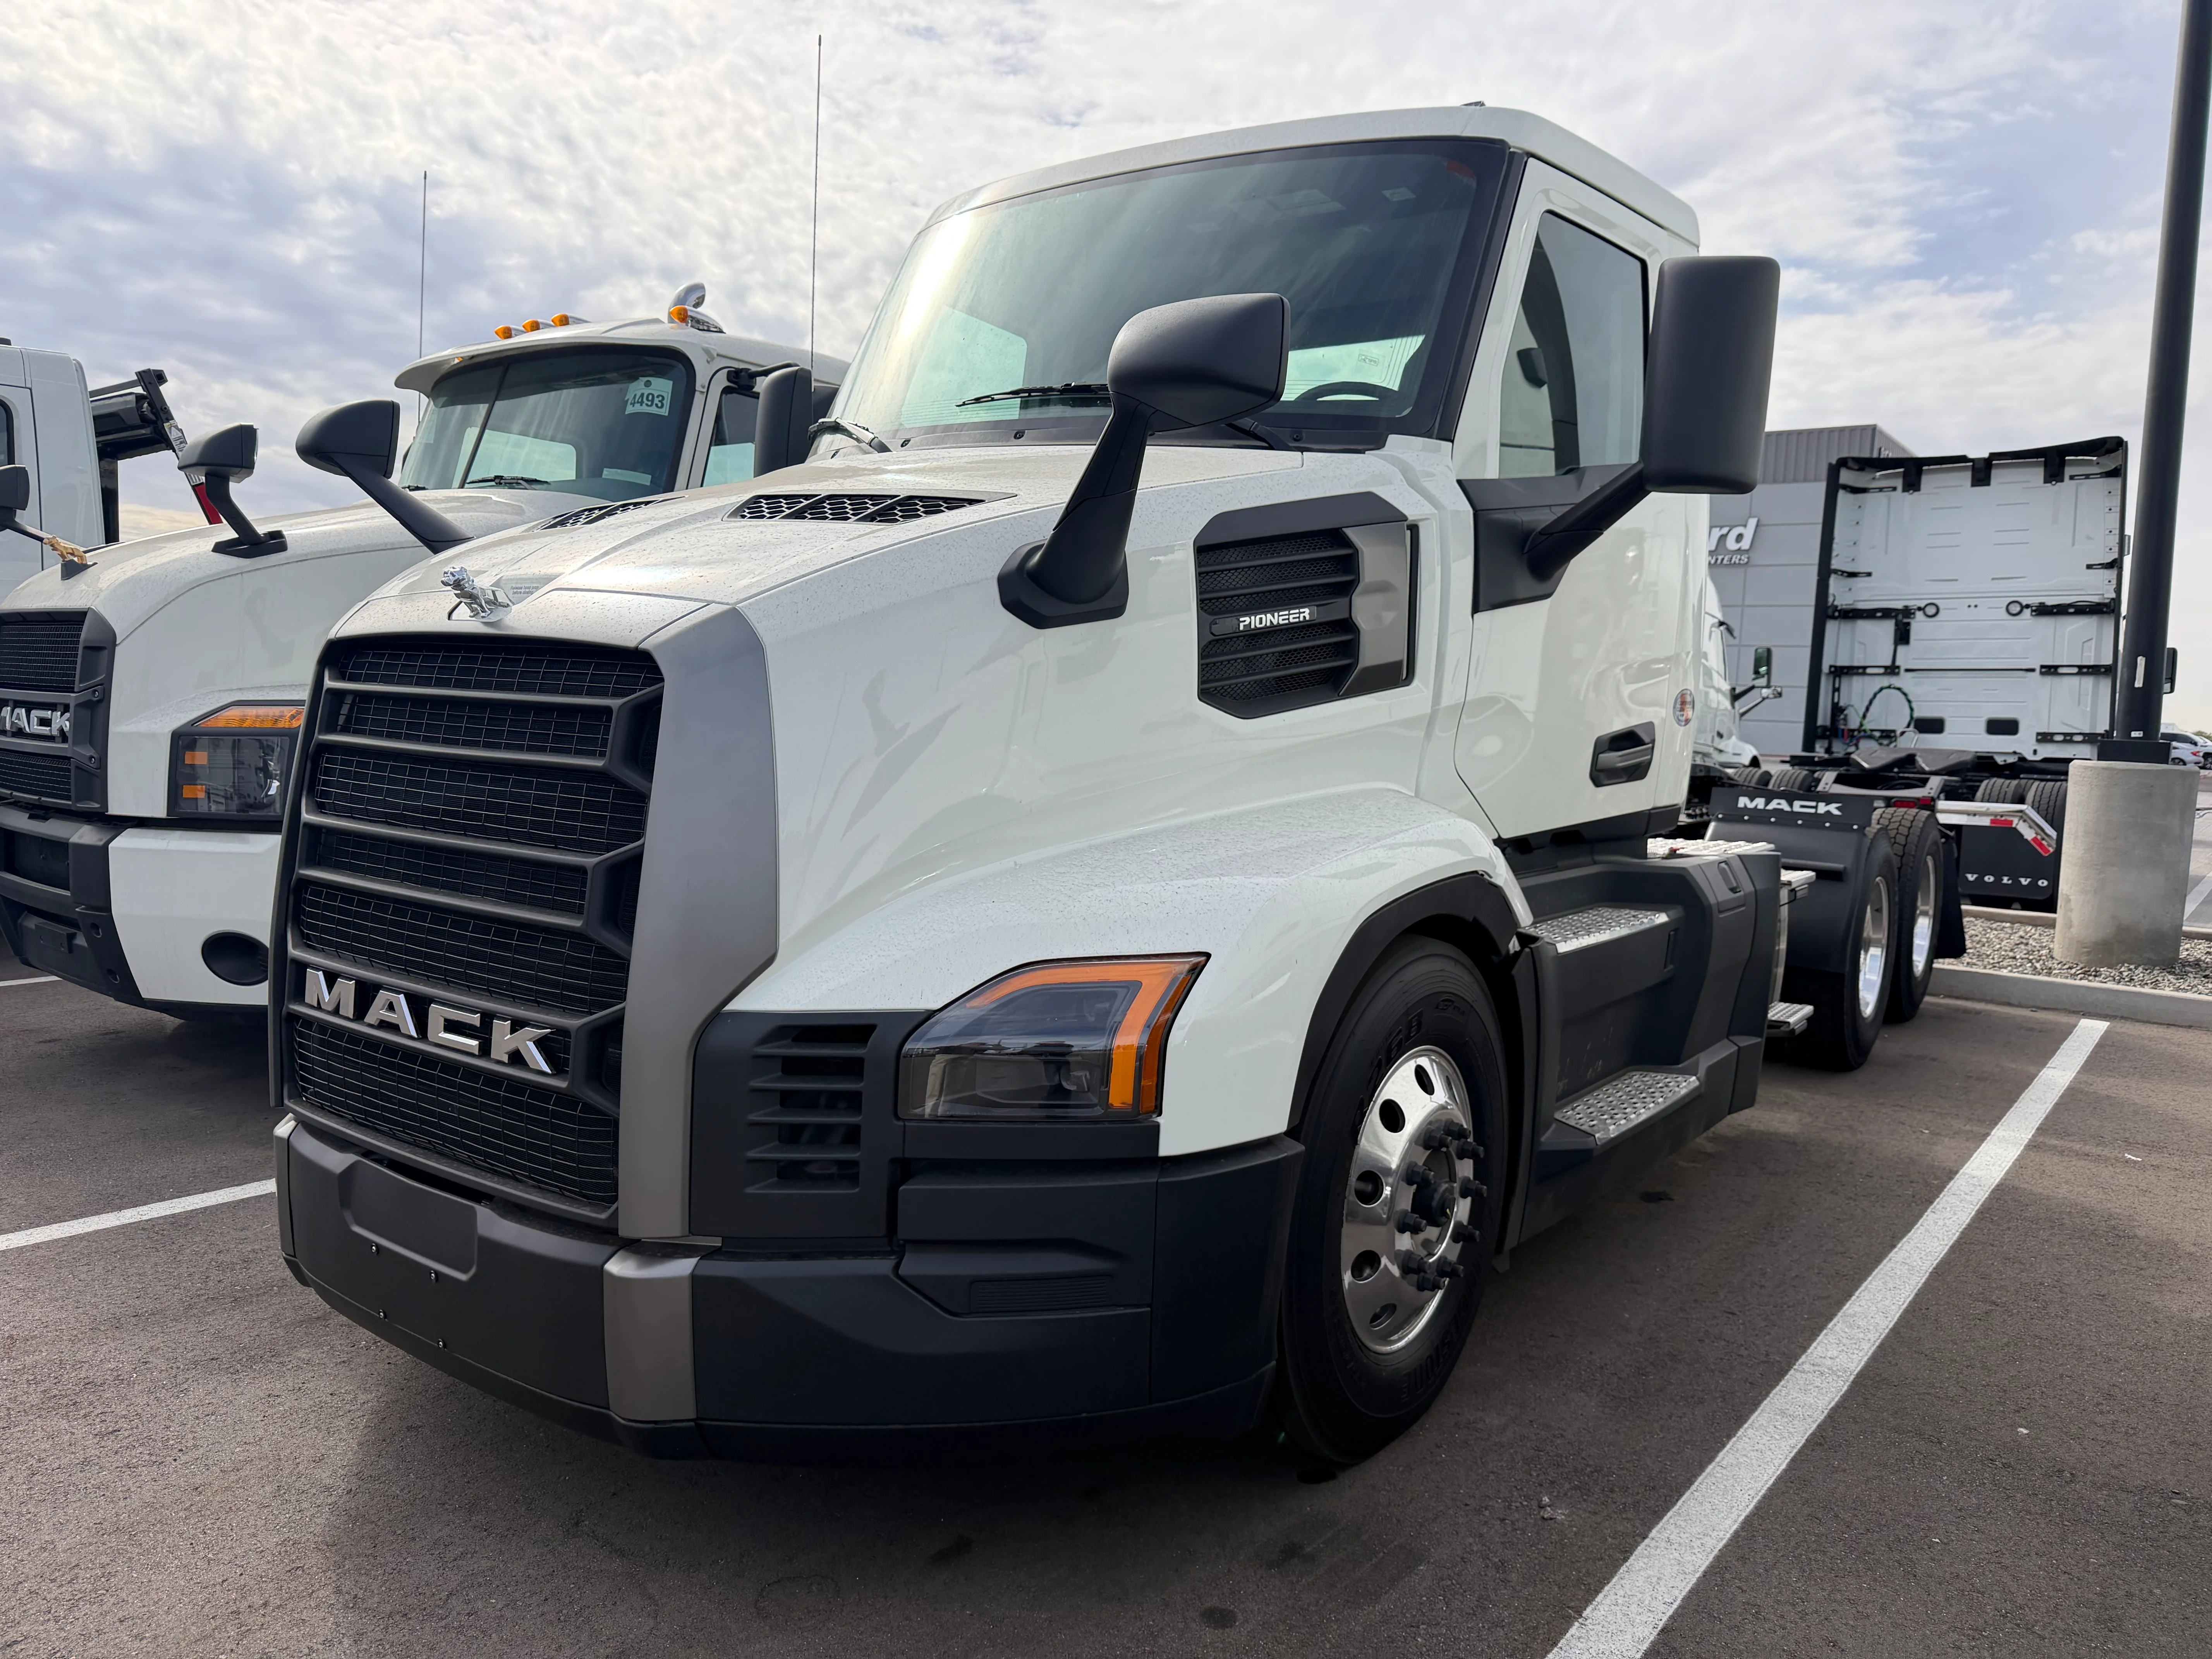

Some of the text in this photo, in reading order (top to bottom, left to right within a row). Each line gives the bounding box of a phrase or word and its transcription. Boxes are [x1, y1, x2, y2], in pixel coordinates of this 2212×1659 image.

[630, 392, 665, 409] 4493
[1239, 608, 1310, 630] PIONEER
[1737, 796, 1843, 815] MACK
[1965, 873, 2049, 887] VOLVO
[305, 968, 556, 1074] MACK
